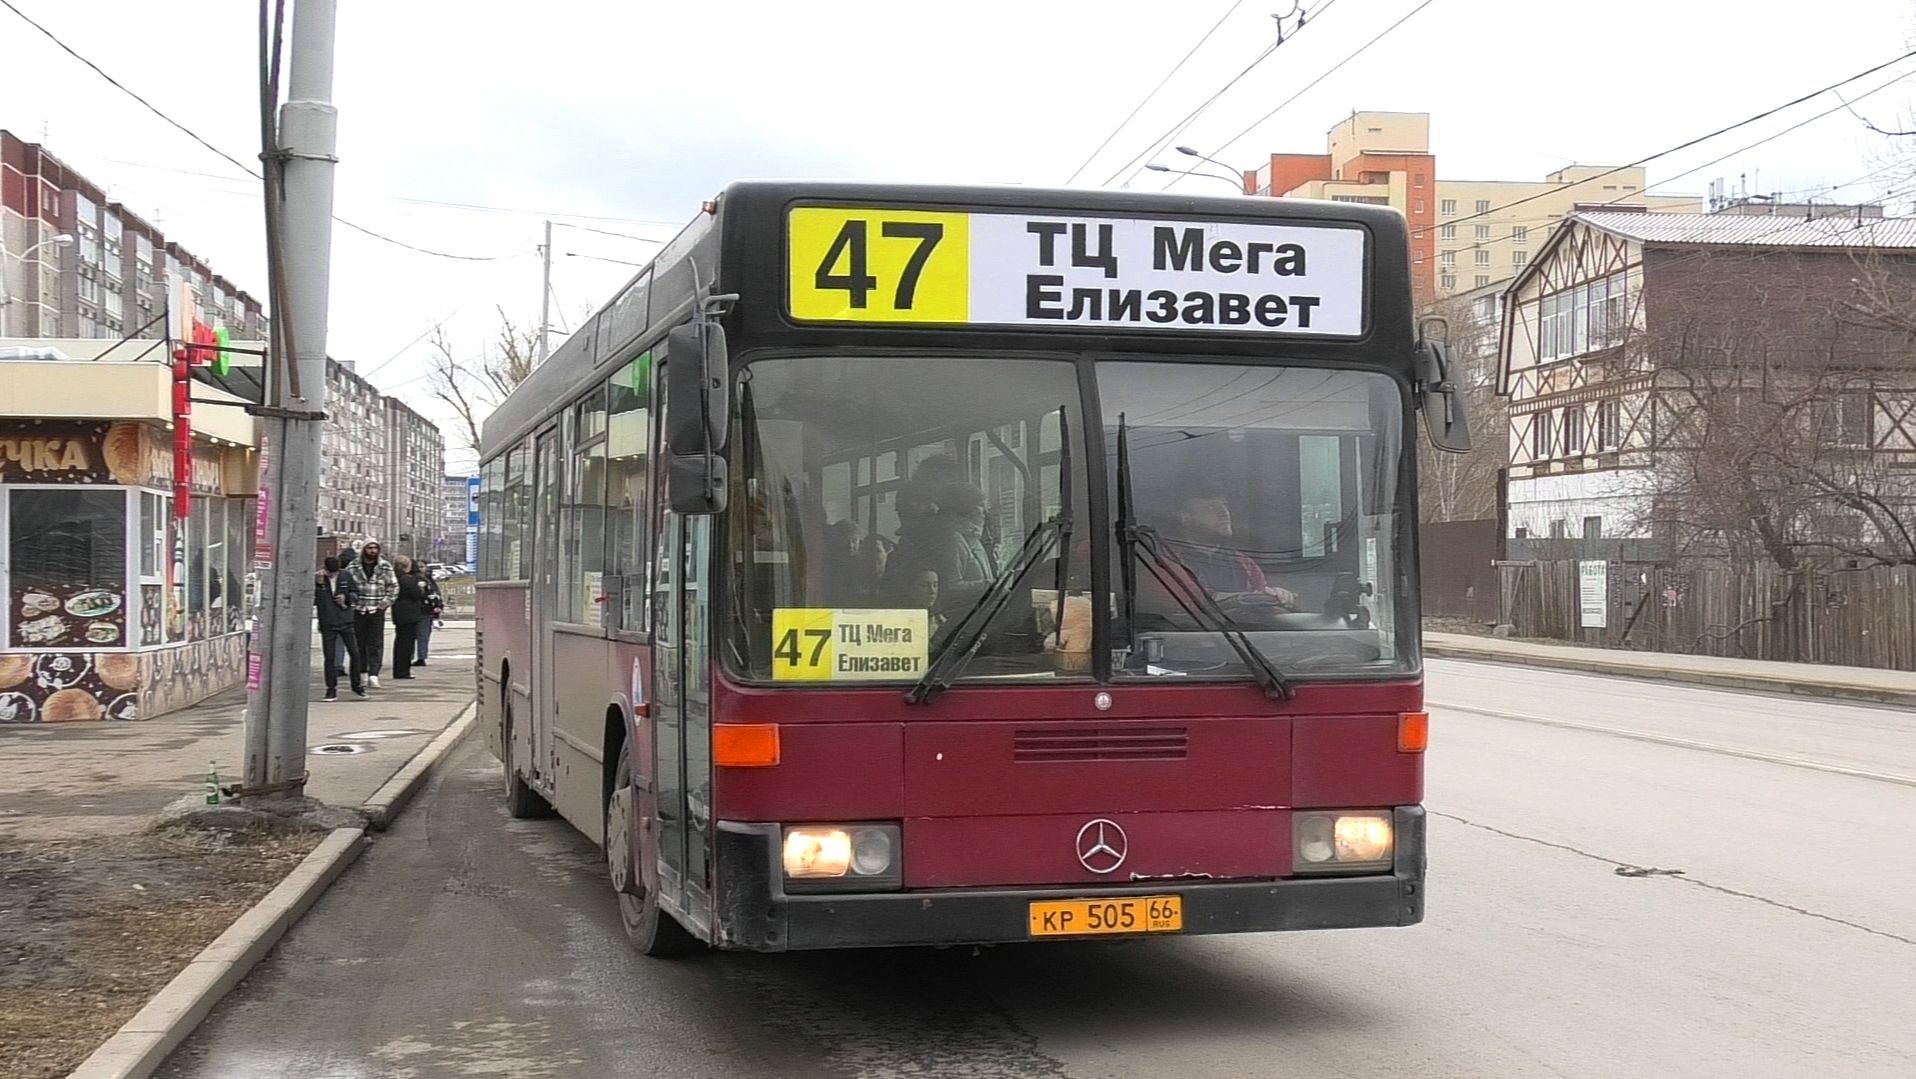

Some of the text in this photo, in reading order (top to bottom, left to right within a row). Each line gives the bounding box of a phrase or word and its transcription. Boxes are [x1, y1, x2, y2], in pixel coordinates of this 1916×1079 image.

[815, 219, 944, 310] 47
[1026, 221, 1306, 279] ТЦ Мега
[1026, 274, 1320, 328] Елизавет
[774, 628, 832, 667] 47
[838, 624, 912, 646] ТЦ Мега
[838, 653, 921, 672] Елизавет
[1087, 903, 1135, 929] 505
[1150, 900, 1173, 919] 66
[1153, 920, 1171, 928] RUS
